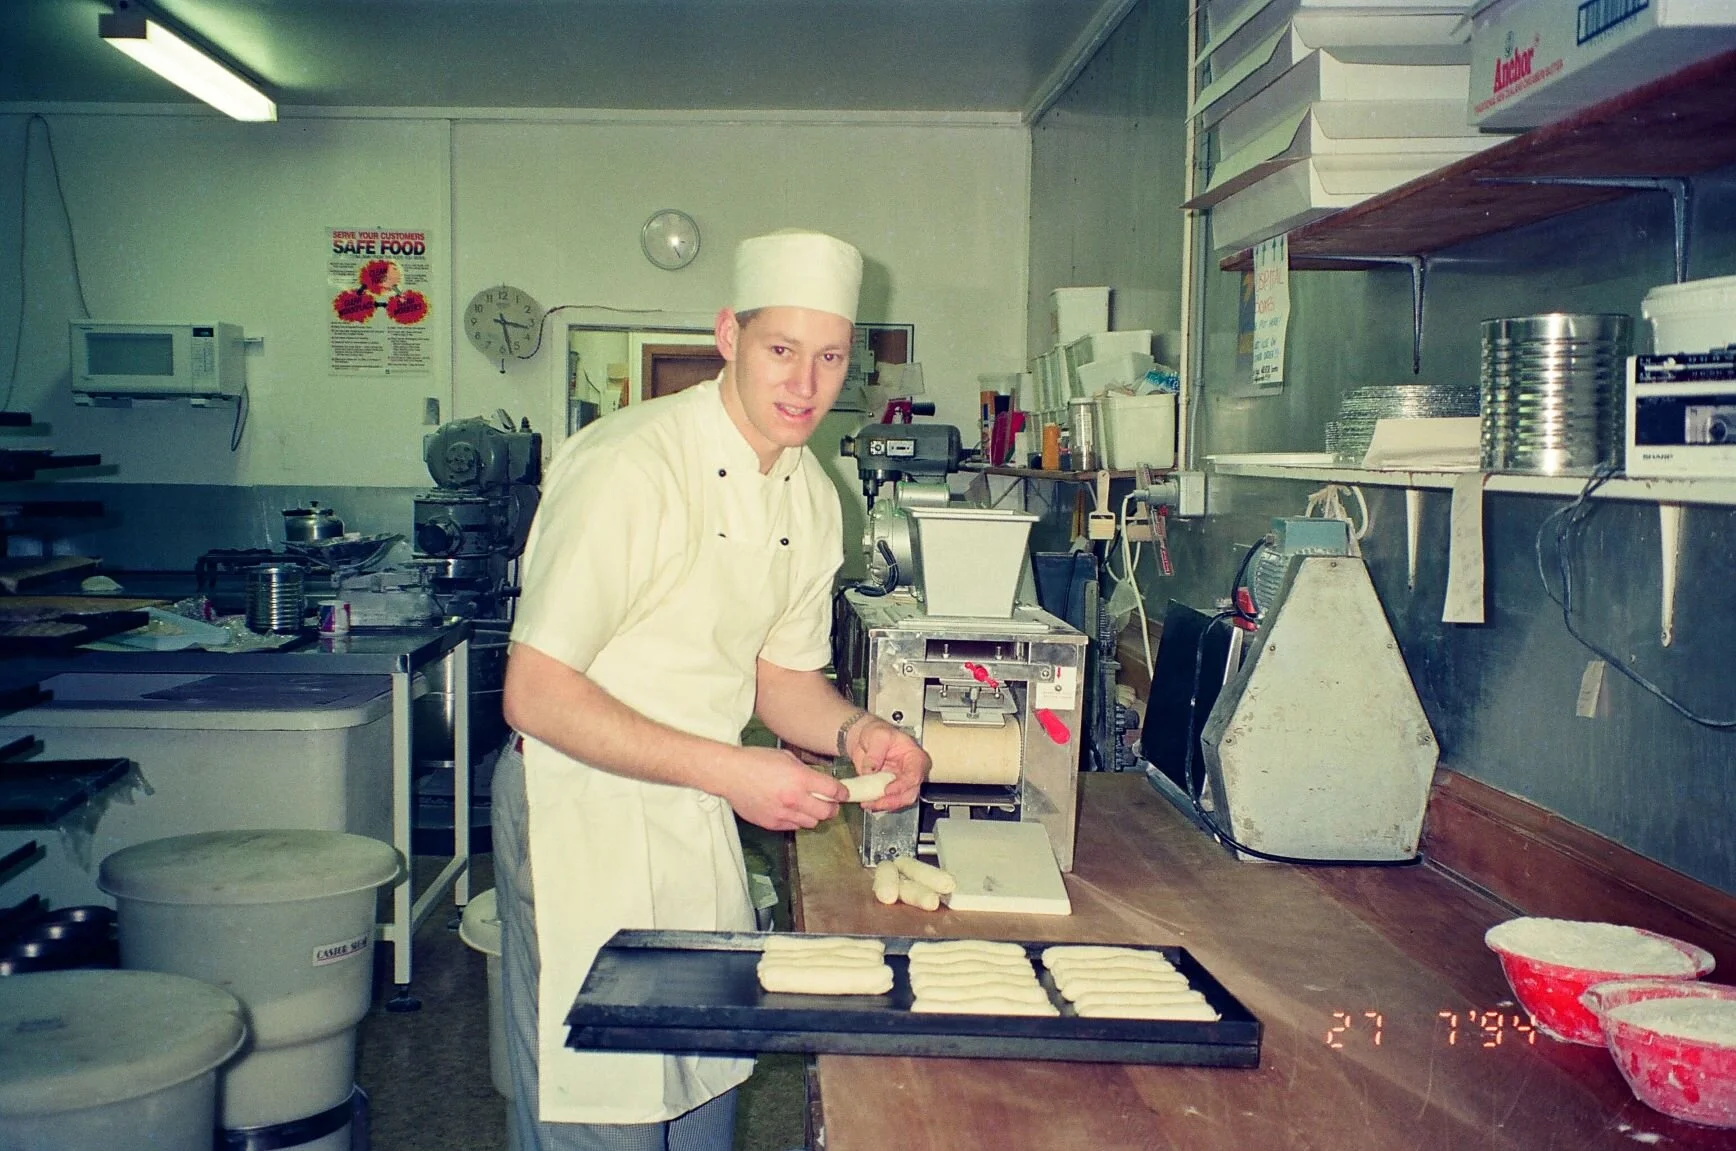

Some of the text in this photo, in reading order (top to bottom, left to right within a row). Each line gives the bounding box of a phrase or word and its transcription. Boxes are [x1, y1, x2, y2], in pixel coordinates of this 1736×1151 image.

[1493, 47, 1535, 94] Anchor
[332, 231, 425, 240] SERVE YOUR CUSTOMERS
[333, 240, 426, 255] SAFE FOOD
[486, 294, 493, 303] 11
[498, 291, 508, 300] 12
[474, 303, 483, 313] 10
[523, 305, 531, 314] 2
[470, 317, 477, 326] 9
[529, 318, 535, 328] 3
[474, 331, 481, 340] 8
[524, 333, 530, 341] 4
[499, 344, 506, 354] 6
[514, 341, 520, 351] 5
